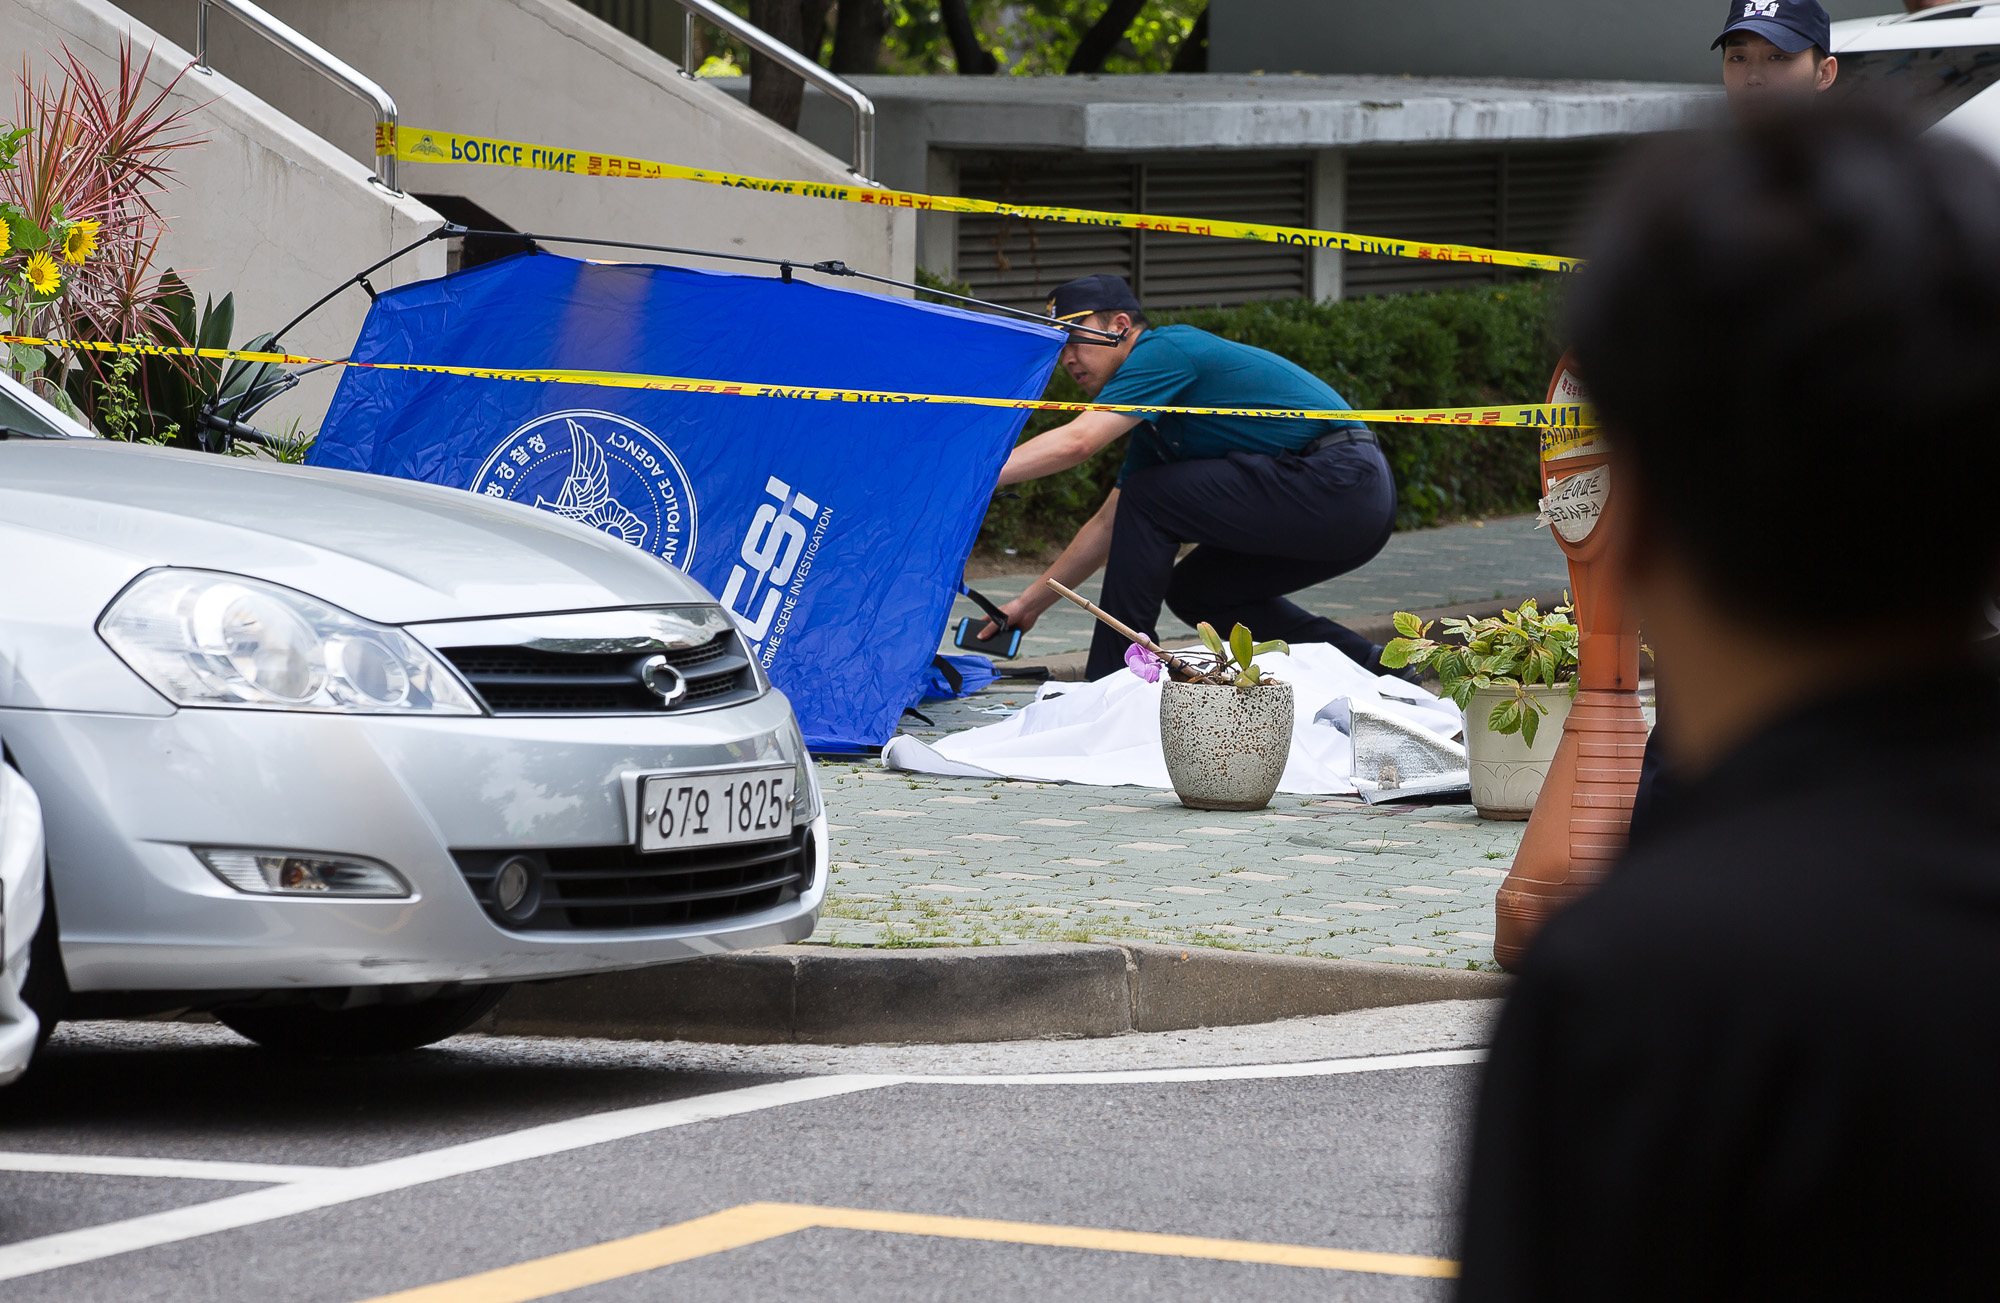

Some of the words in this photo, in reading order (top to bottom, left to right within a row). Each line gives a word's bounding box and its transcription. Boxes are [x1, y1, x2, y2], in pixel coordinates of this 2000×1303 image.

[605, 431, 665, 477] AGENCY
[657, 477, 681, 533] POLICE
[761, 632, 783, 669] CRIME
[774, 595, 798, 635] SCENE
[788, 506, 834, 598] INVESTIGATION
[658, 787, 709, 839] 67오
[724, 778, 783, 834] 1825
